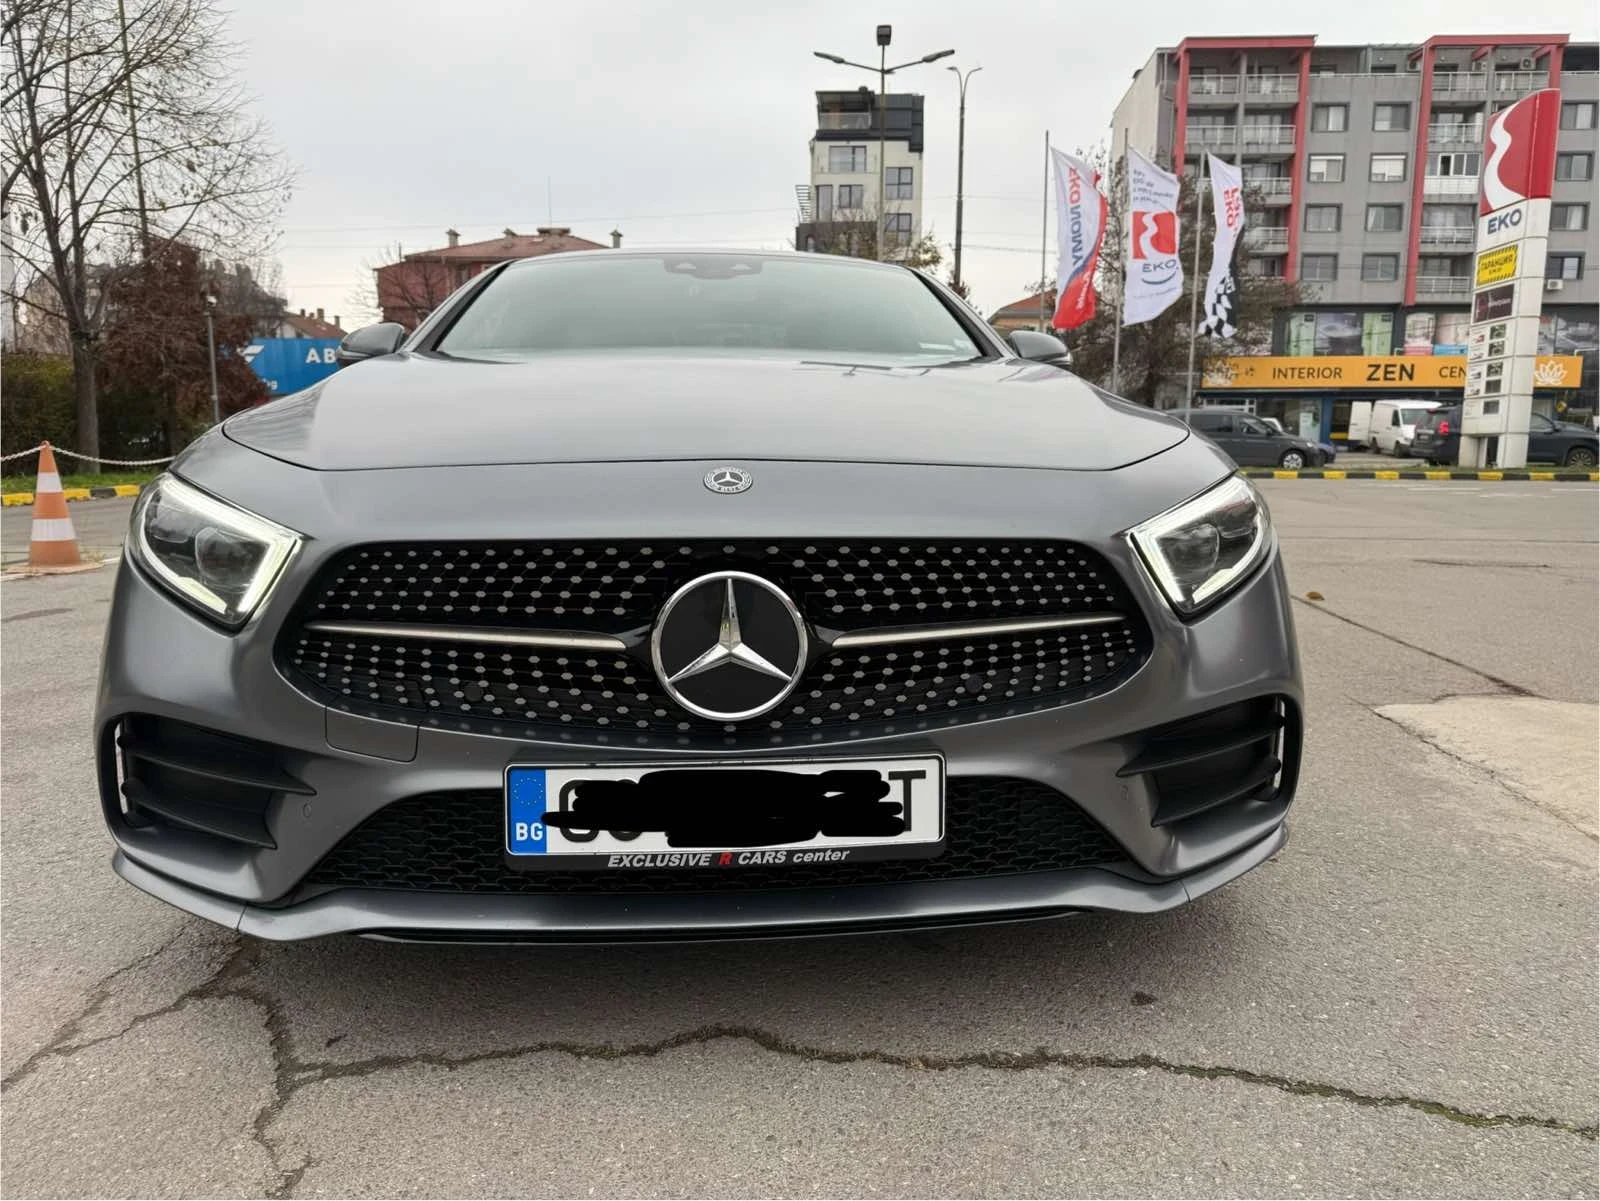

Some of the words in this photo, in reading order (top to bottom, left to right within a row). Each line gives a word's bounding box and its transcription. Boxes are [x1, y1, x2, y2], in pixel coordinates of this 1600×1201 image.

[1487, 208, 1522, 234] EKO
[1142, 259, 1177, 272] EKO
[1272, 367, 1342, 379] INTERIOR
[1366, 363, 1415, 381] ZEN
[1439, 366, 1467, 378] CEN
[515, 822, 543, 841] BG
[607, 853, 712, 868] EXCLUSIVE
[738, 851, 786, 865] CARS
[793, 849, 850, 864] center
